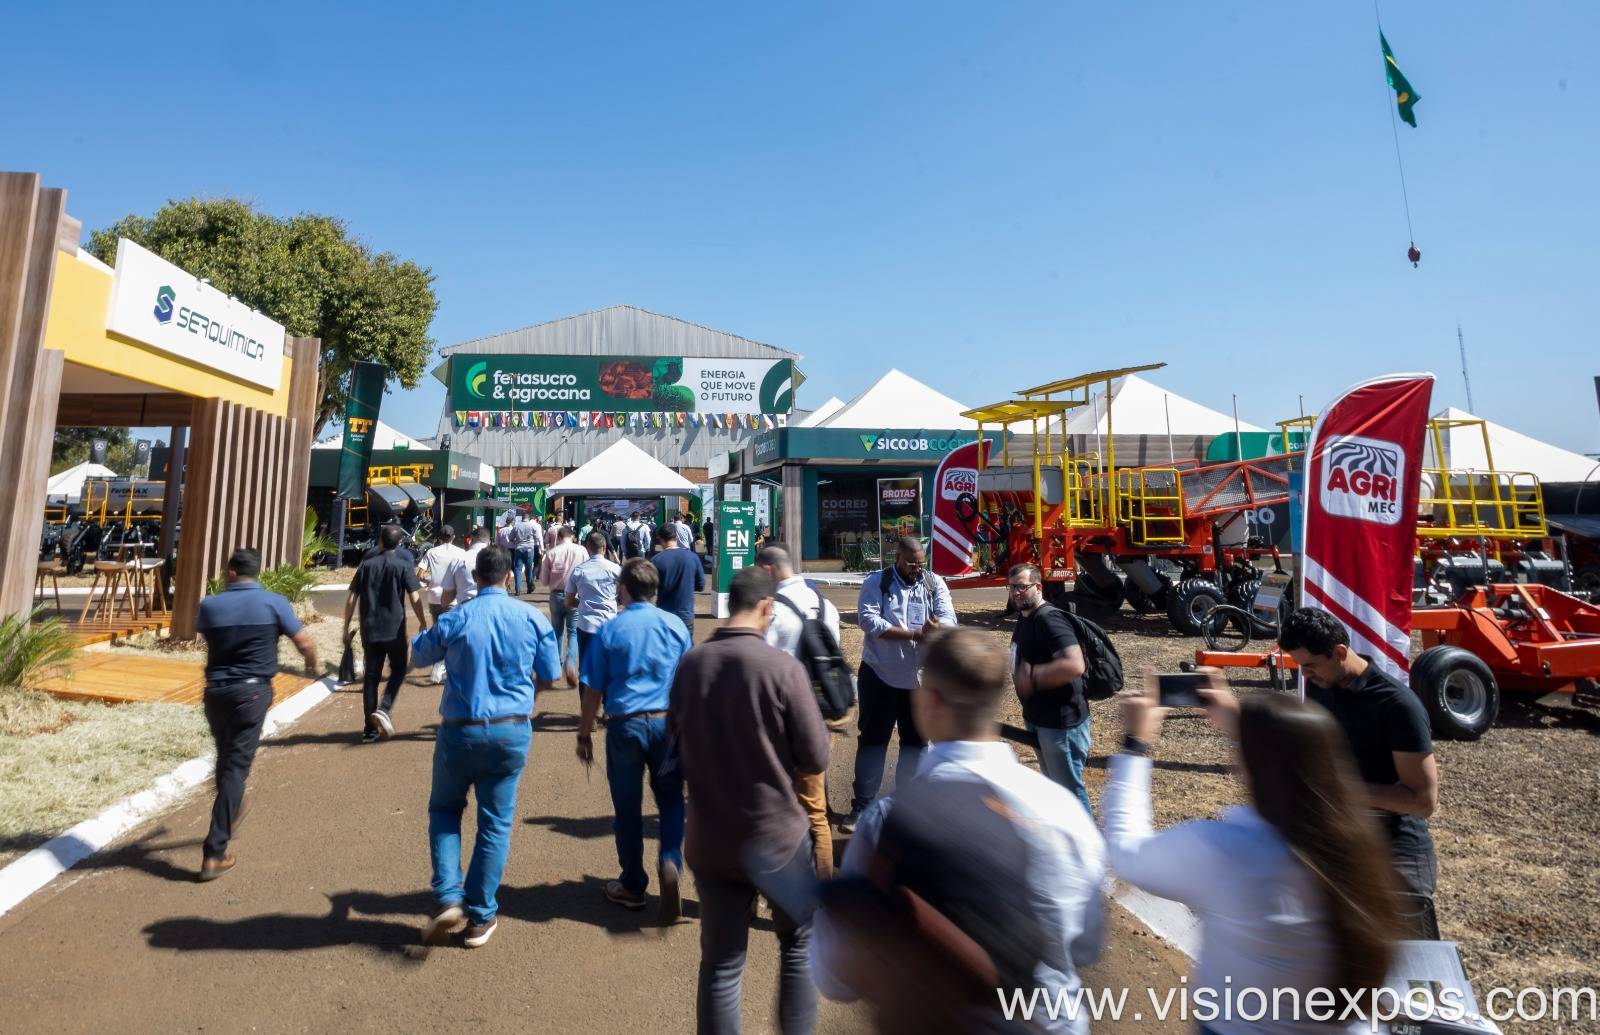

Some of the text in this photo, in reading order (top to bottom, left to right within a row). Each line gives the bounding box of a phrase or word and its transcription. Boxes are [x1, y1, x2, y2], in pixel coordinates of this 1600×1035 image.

[700, 370, 746, 379] ENERGIA
[700, 381, 756, 391] QUE MOVE
[492, 385, 590, 403] & agrocana
[700, 392, 753, 401] O FUTURO
[944, 480, 976, 493] AGRI
[1327, 467, 1398, 502] AGRI
[882, 489, 917, 499] BROTAS
[822, 499, 868, 509] COCRED
[1368, 501, 1396, 514] MEC
[726, 530, 749, 548] EN
[1052, 570, 1074, 578] BROTAS
